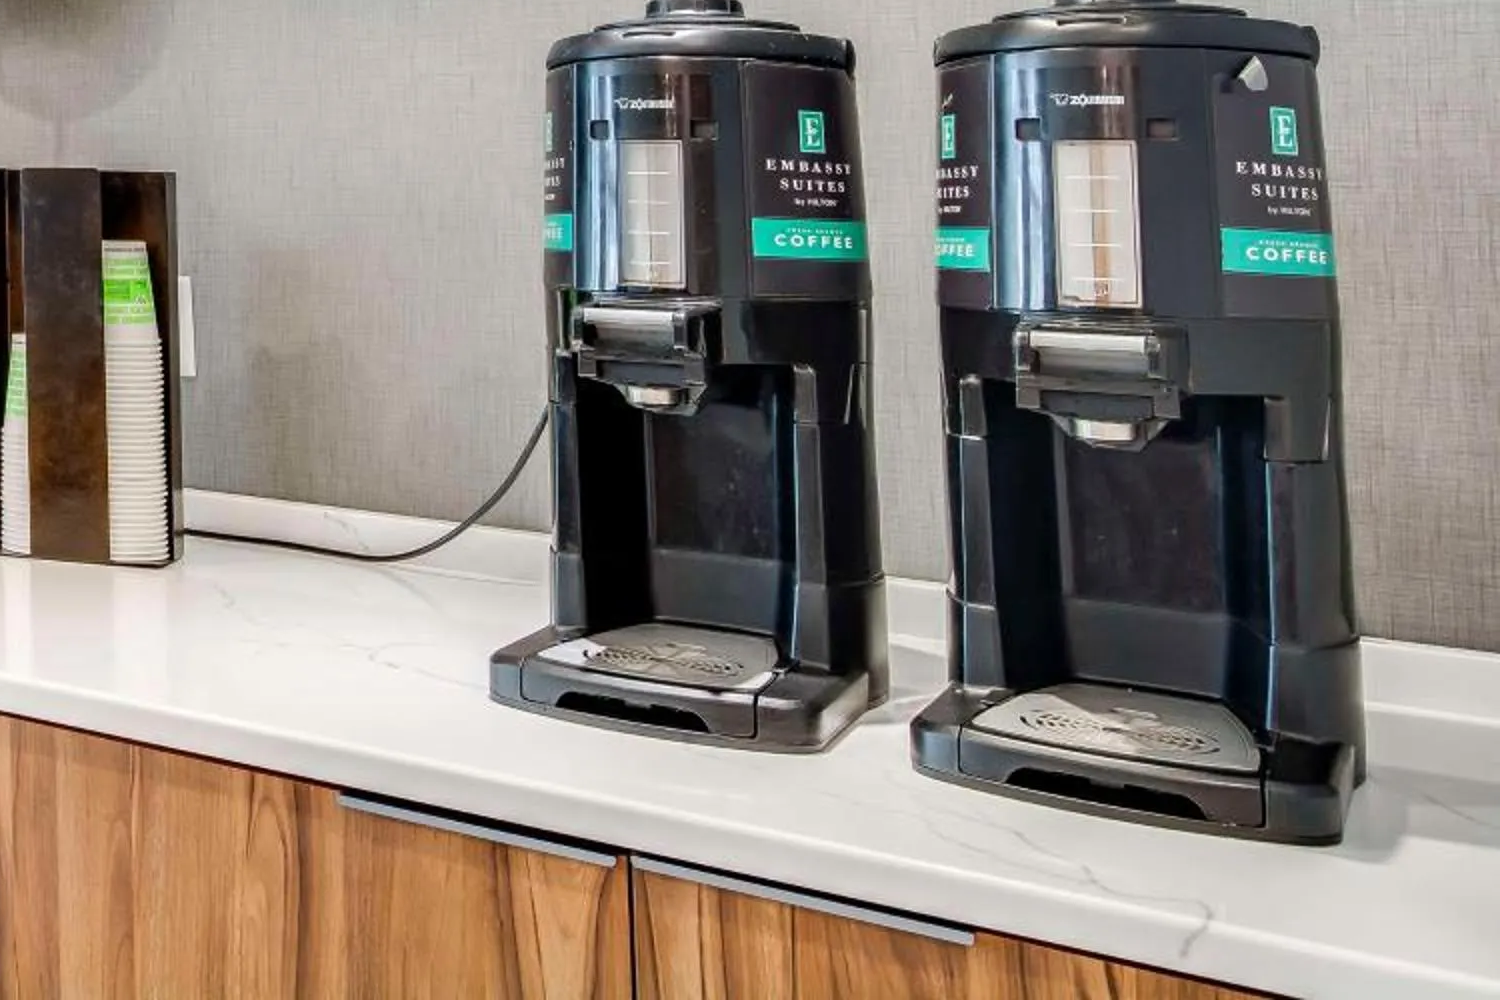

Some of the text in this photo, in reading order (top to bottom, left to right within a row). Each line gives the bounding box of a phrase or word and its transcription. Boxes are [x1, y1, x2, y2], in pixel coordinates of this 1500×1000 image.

[765, 158, 851, 175] EMBASSY
[1236, 161, 1323, 180] EMBASSY
[780, 178, 845, 193] SUITES
[1251, 183, 1319, 201] SUITES
[774, 233, 853, 249] COFFEE
[1245, 246, 1329, 265] COFFEE
